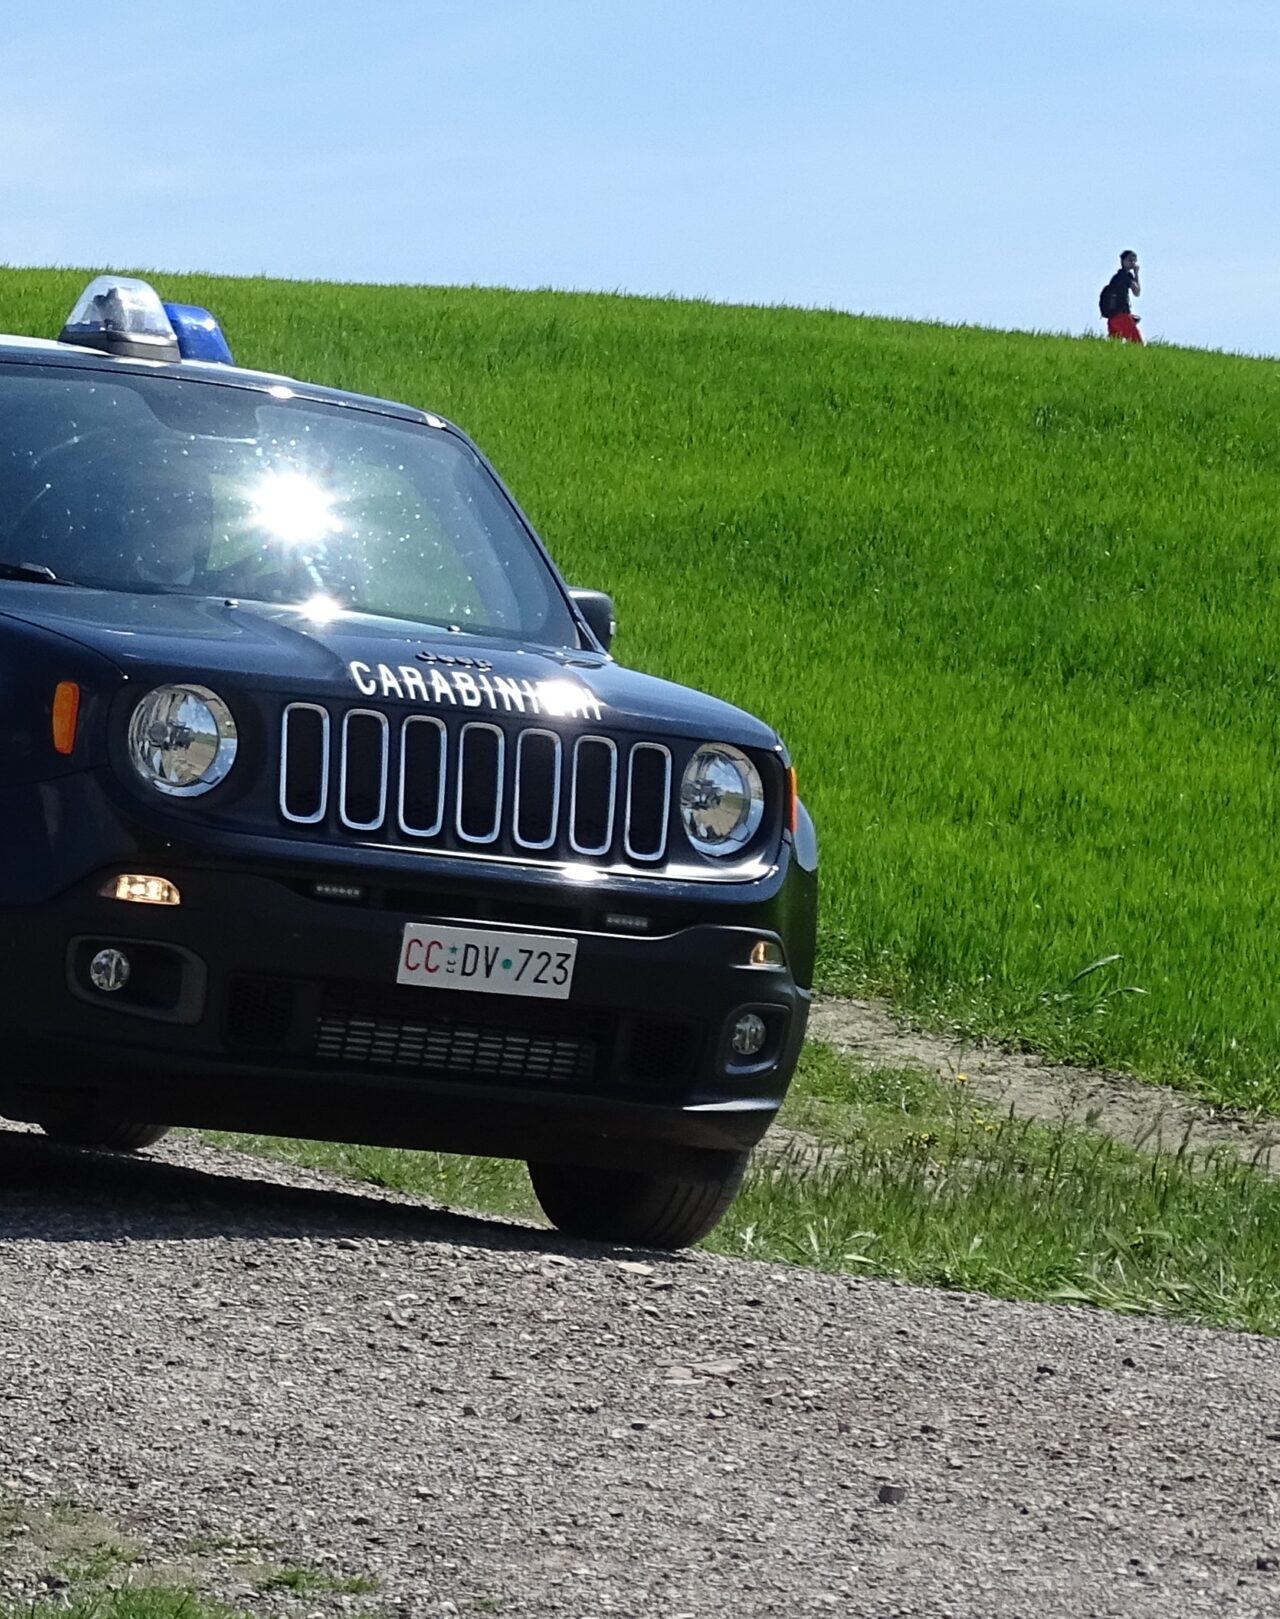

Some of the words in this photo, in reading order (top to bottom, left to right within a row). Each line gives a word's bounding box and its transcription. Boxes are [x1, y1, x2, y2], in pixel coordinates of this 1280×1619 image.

[349, 660, 602, 720] CARABINII
[405, 938, 443, 973] CC
[460, 943, 500, 978] DV
[515, 948, 571, 985] 723
